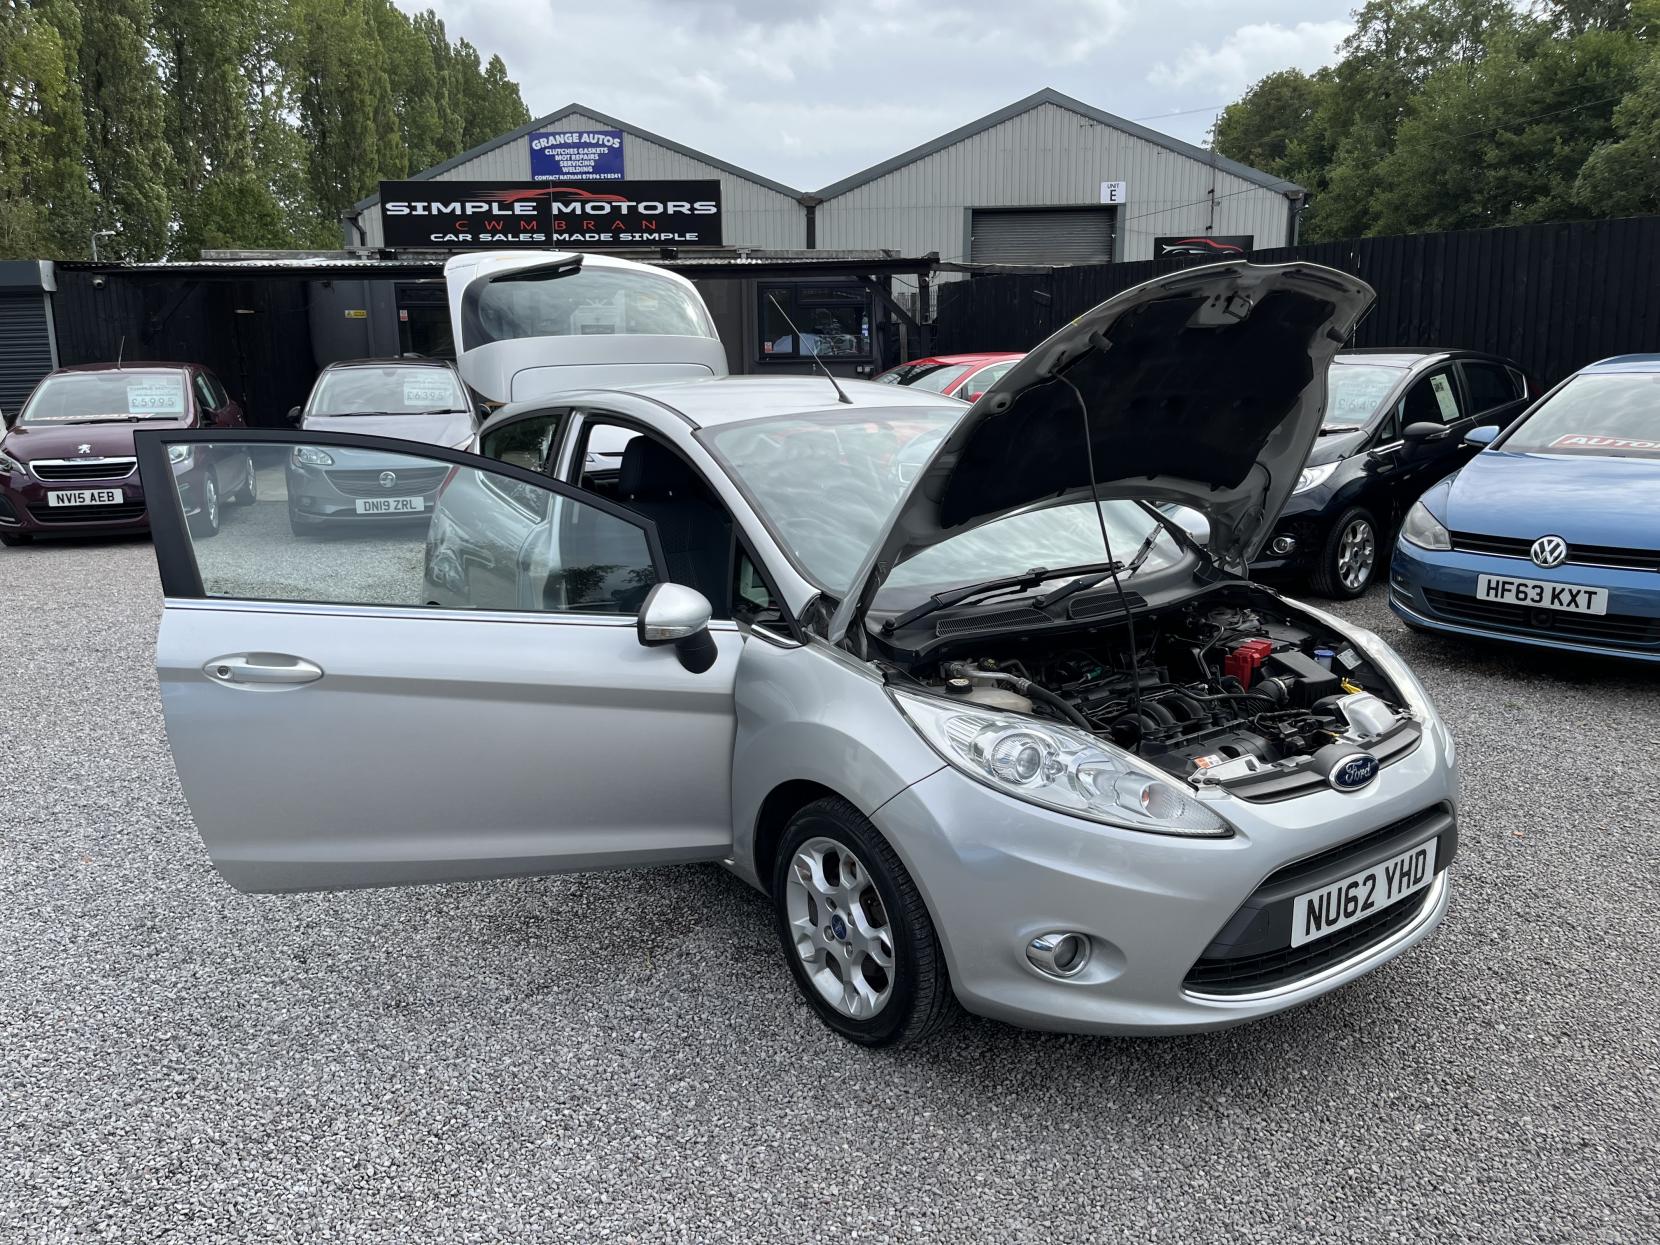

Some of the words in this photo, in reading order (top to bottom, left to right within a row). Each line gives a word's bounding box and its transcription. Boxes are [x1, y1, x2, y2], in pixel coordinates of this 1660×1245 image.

[532, 133, 579, 150] GRANGE
[581, 133, 621, 148] AUTOS
[1109, 189, 1116, 201] E
[385, 201, 538, 215] SIMPLE
[552, 201, 718, 215] MOTORS
[455, 219, 657, 231] CWMBRAN
[430, 233, 472, 242] CAR
[479, 233, 546, 241] SALES
[553, 233, 613, 241] MADE
[619, 233, 699, 241] SIMPLE
[131, 397, 175, 408] £5995
[56, 492, 85, 505] NV15
[90, 491, 115, 503] AEB
[363, 500, 390, 512] DN19
[393, 499, 417, 511] ZRL
[1486, 578, 1544, 604] HF63
[1550, 586, 1597, 610] KXT
[1345, 760, 1371, 783] Ford
[1305, 873, 1377, 937] NU62
[1384, 848, 1427, 900] YHD
